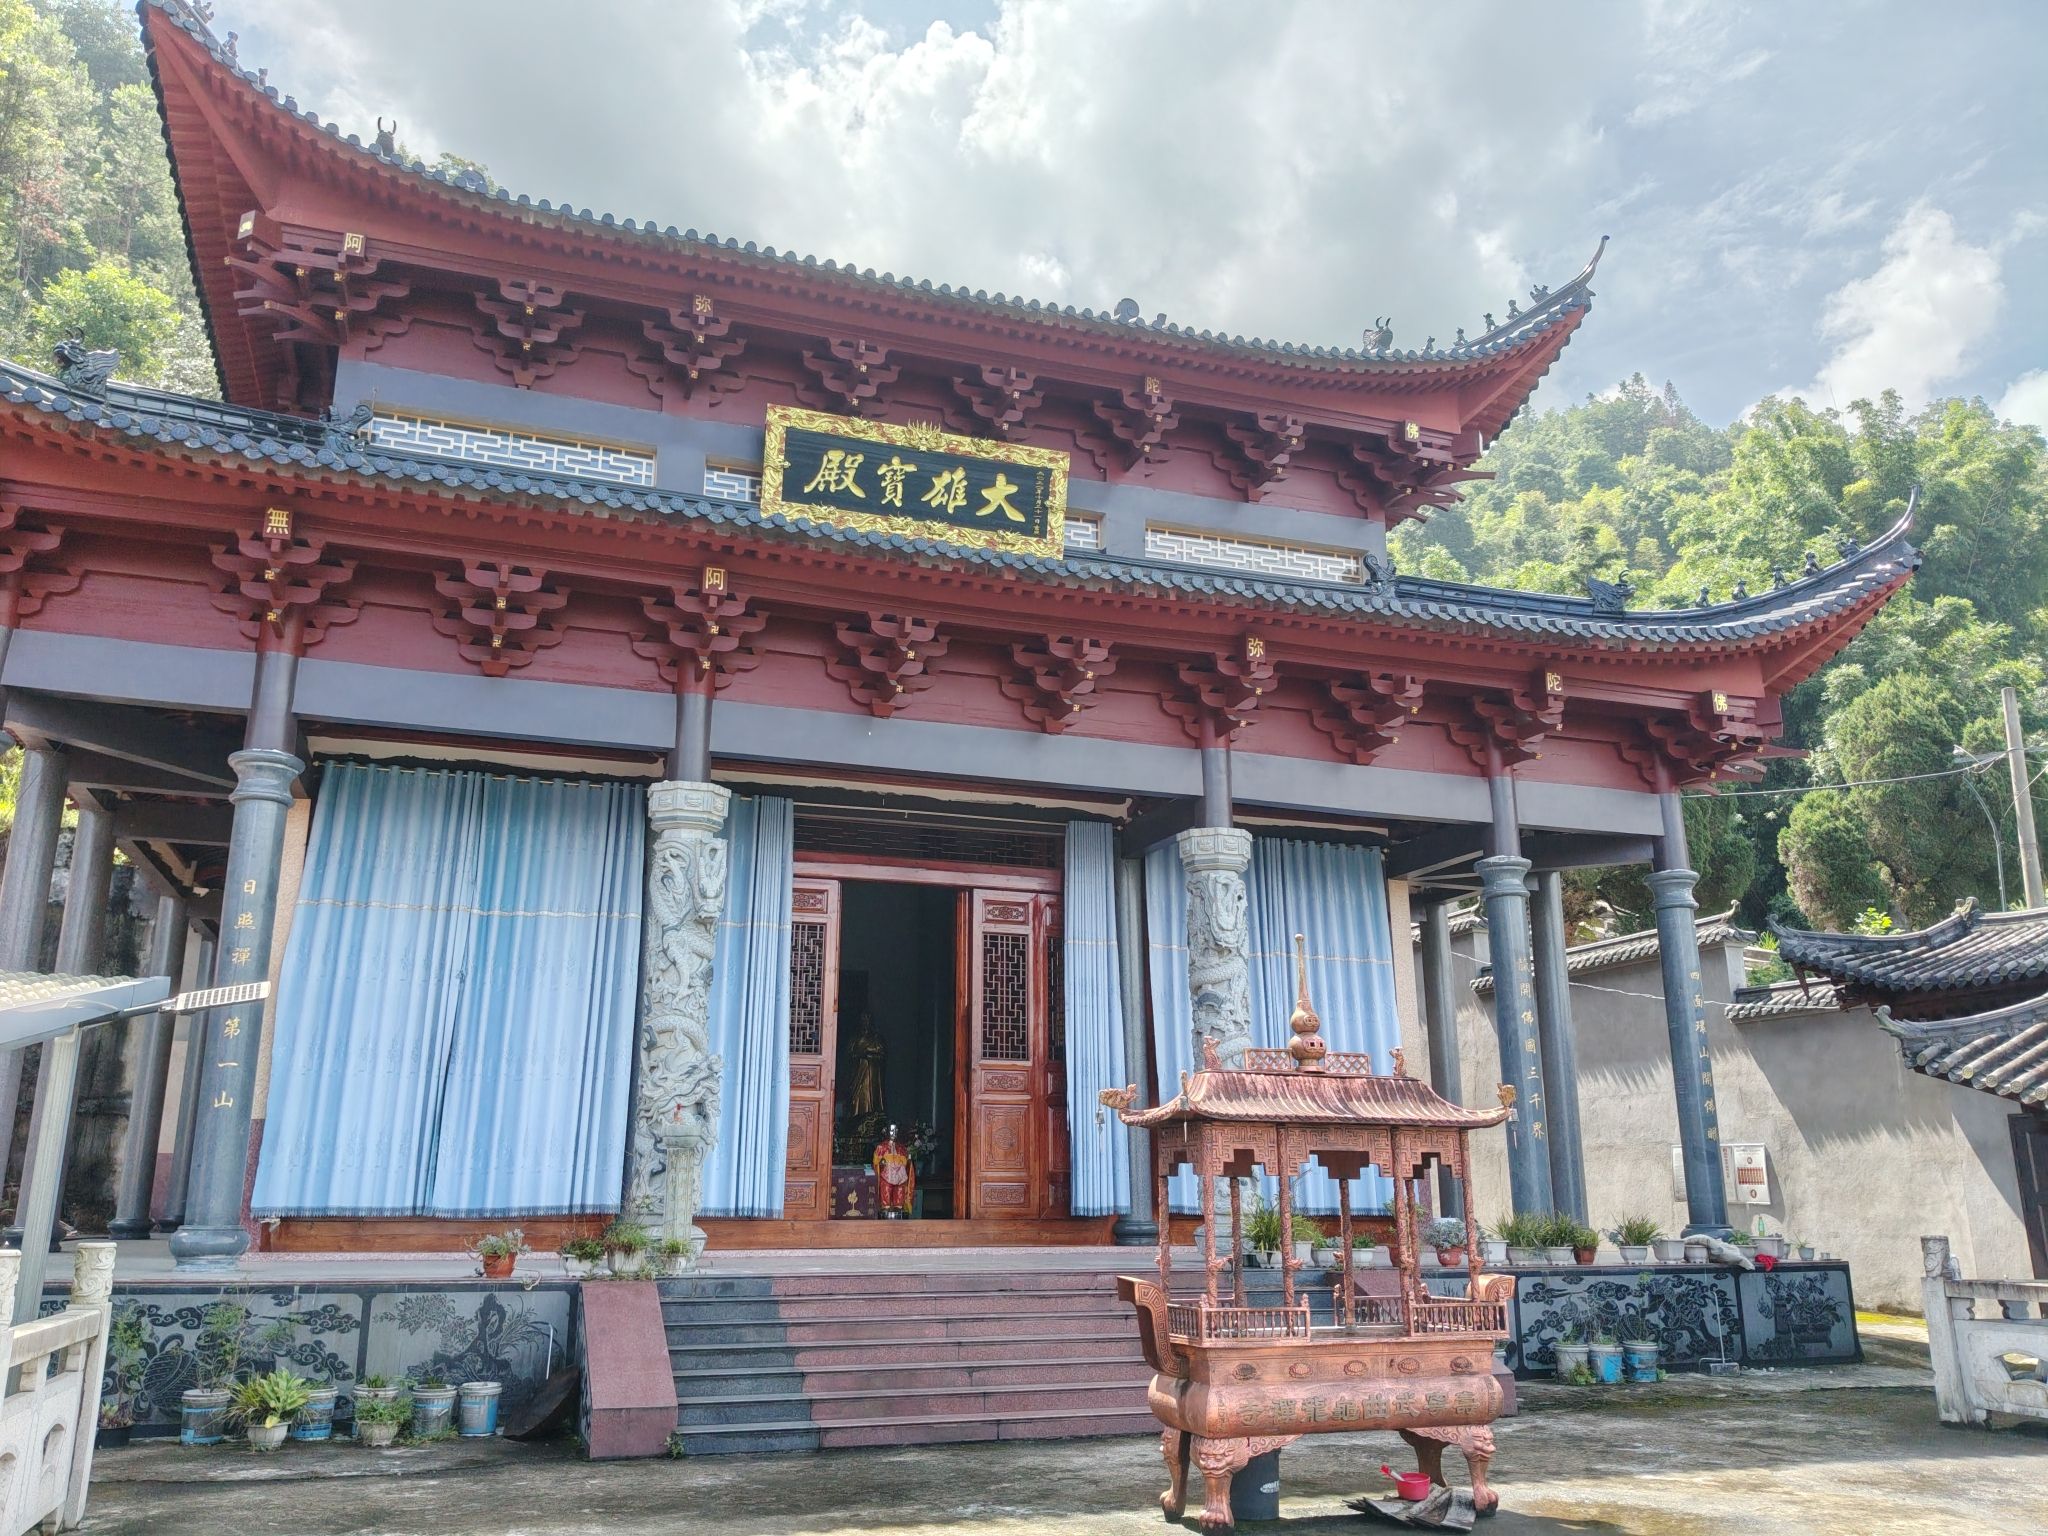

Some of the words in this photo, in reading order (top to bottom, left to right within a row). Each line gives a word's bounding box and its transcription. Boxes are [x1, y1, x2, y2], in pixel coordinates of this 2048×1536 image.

[344, 232, 364, 253] 阿
[1406, 423, 1419, 440] 佛
[266, 507, 290, 535] 無
[705, 567, 725, 592] 阿
[1248, 638, 1264, 658] 弥
[1714, 694, 1728, 711] 佛
[213, 879, 257, 1108] 日照禪第一山
